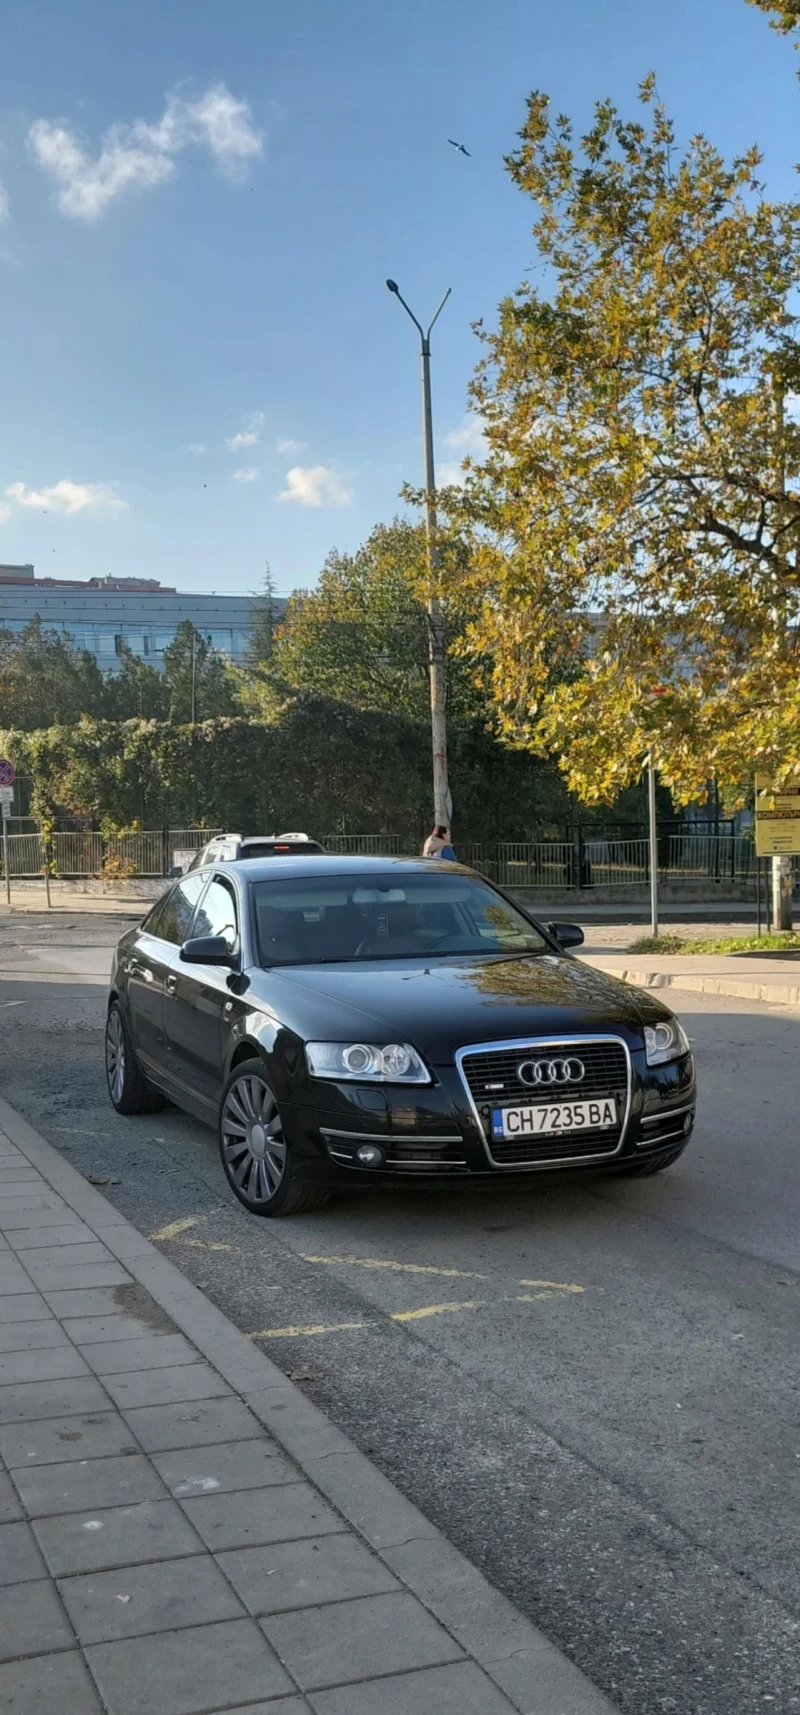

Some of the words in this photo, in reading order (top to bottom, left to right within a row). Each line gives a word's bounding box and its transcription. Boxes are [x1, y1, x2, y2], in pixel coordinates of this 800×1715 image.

[506, 1110, 534, 1133] CH
[537, 1105, 585, 1130] 7235
[588, 1103, 614, 1125] BA
[493, 1126, 503, 1134] BG
